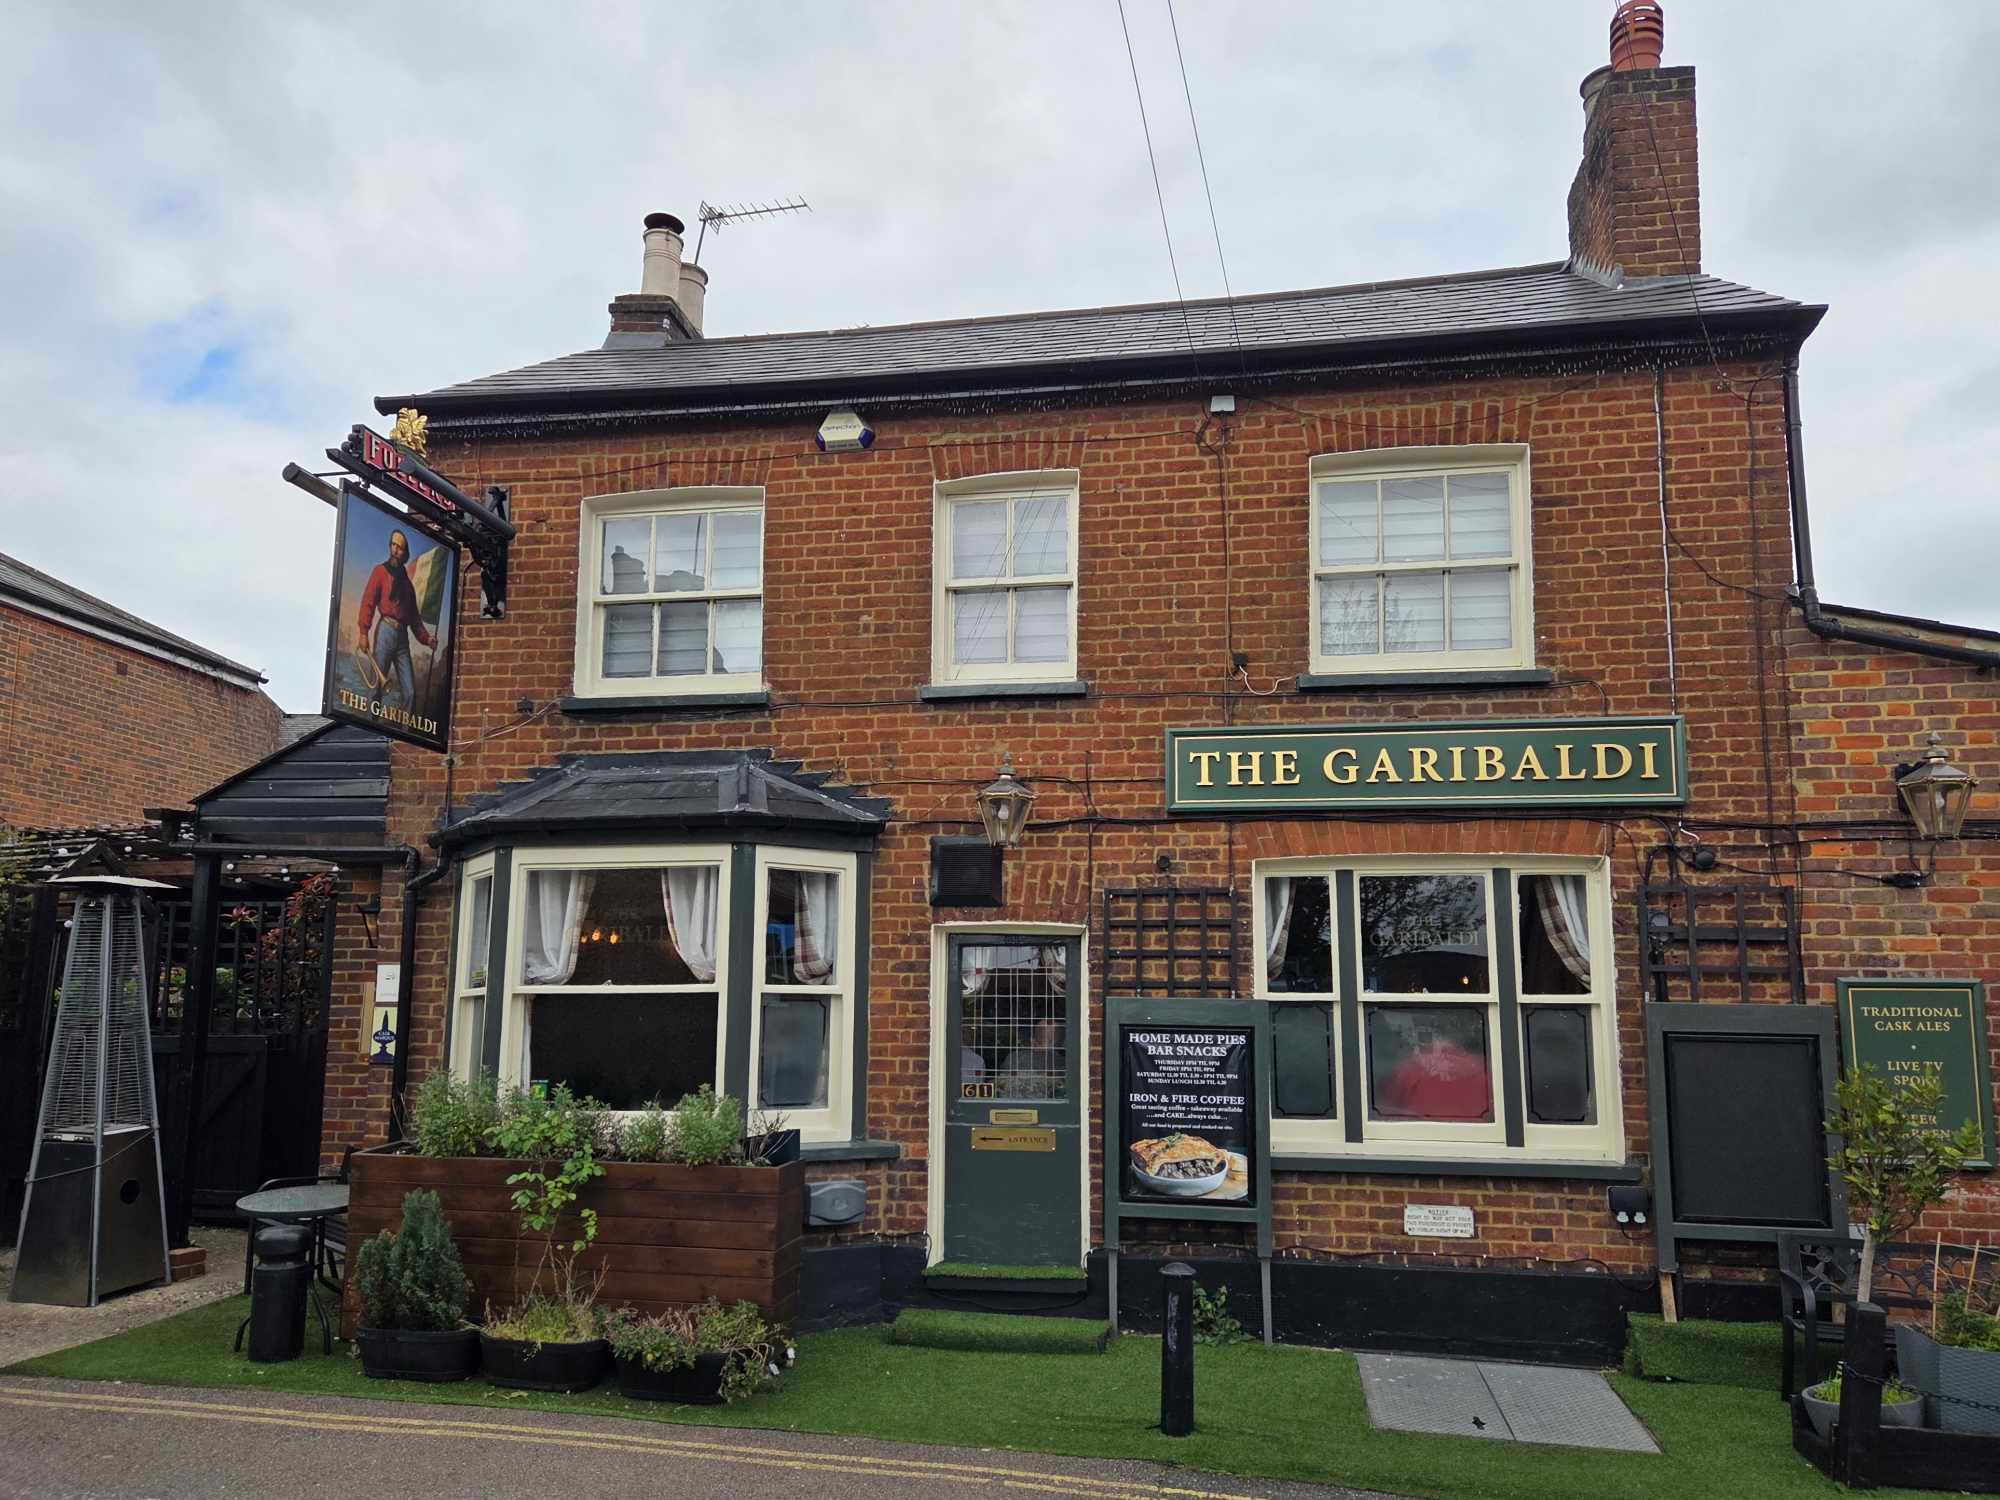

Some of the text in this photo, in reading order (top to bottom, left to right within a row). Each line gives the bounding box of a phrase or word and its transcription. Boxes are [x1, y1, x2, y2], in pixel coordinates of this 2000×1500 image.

[340, 688, 438, 735] THE GARIBALDI
[1188, 741, 1661, 787] THE GARIBALDI
[1861, 1007, 1962, 1017] TRADITIONAL
[1874, 1021, 1951, 1032] CASK ALES
[1129, 1033, 1246, 1045] HOME MADE PIES
[1147, 1045, 1227, 1057] BAR SNACKS
[1887, 1061, 1920, 1071] LIVE
[965, 1085, 989, 1097] 61
[1129, 1093, 1245, 1105] IRON & FIRE COFFEE
[1008, 1136, 1048, 1144] ENTRANCE
